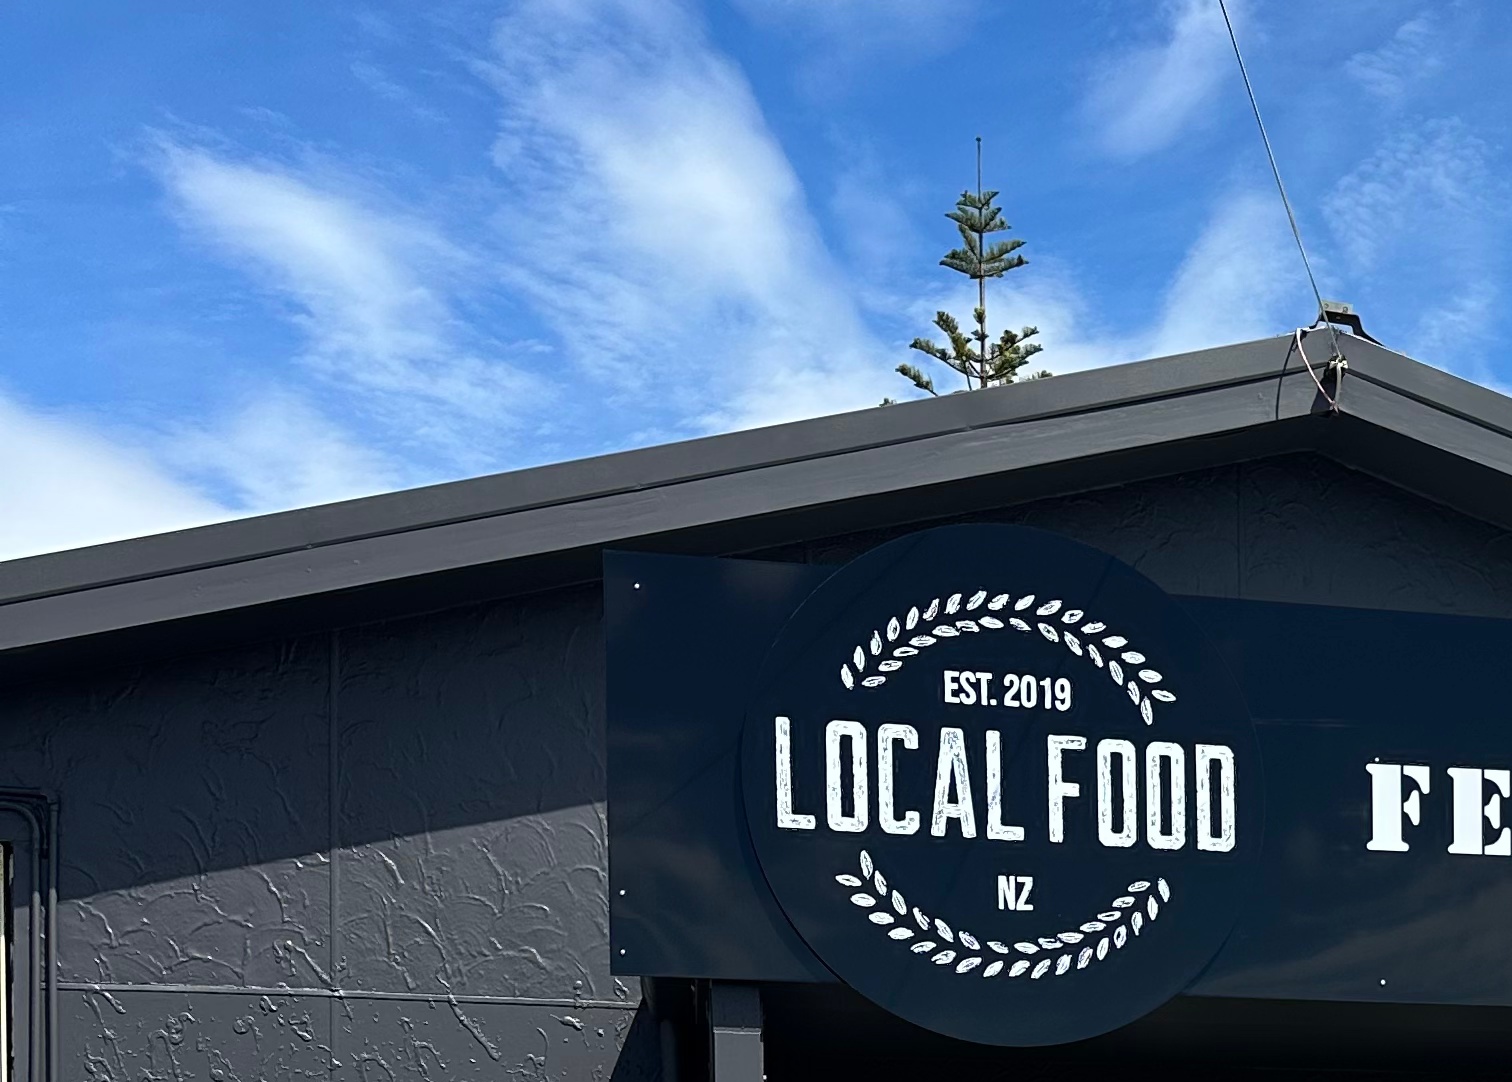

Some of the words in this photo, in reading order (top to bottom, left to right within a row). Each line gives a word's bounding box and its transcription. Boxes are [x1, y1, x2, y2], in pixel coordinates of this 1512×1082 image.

[943, 670, 998, 706] EST.
[1003, 673, 1072, 712] 2019
[775, 716, 1025, 842] LOCAL
[1047, 734, 1236, 853] FOOD
[997, 875, 1034, 911] NZ
